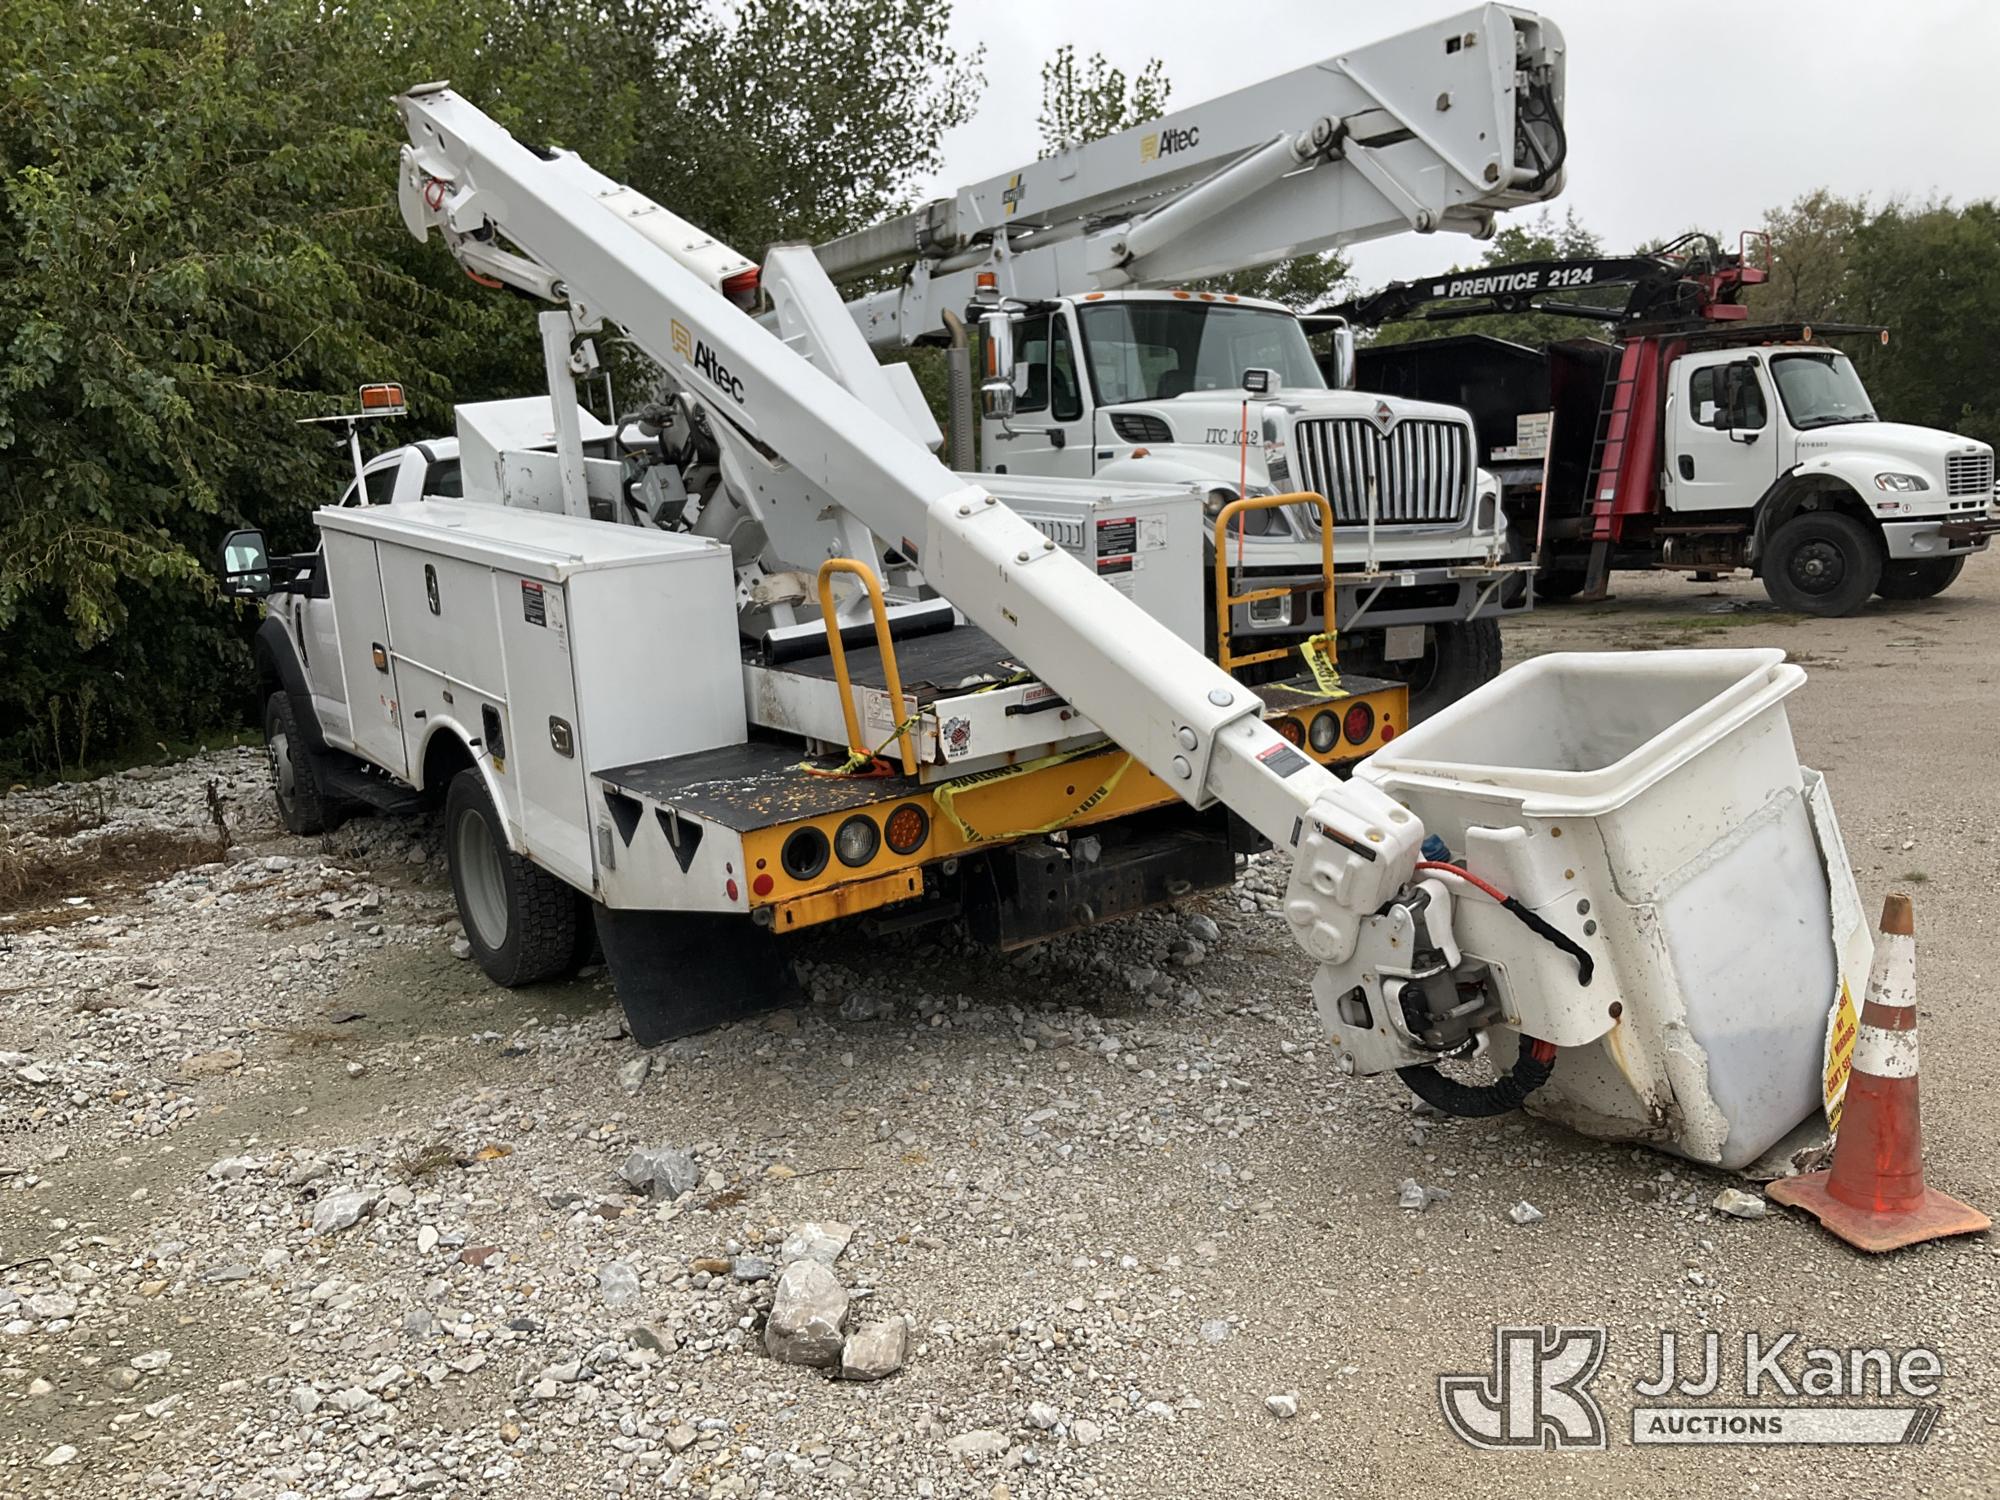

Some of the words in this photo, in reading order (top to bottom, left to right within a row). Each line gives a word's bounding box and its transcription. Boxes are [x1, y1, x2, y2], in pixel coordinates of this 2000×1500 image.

[1158, 126, 1200, 159] Altec
[1448, 271, 1540, 298] PRENTICE
[1547, 266, 1594, 287] 2124
[693, 338, 745, 405] Altec
[1205, 427, 1229, 444] ITC
[1834, 1022, 1856, 1057] MIRRORS
[1827, 1066, 1843, 1093] CAN'T
